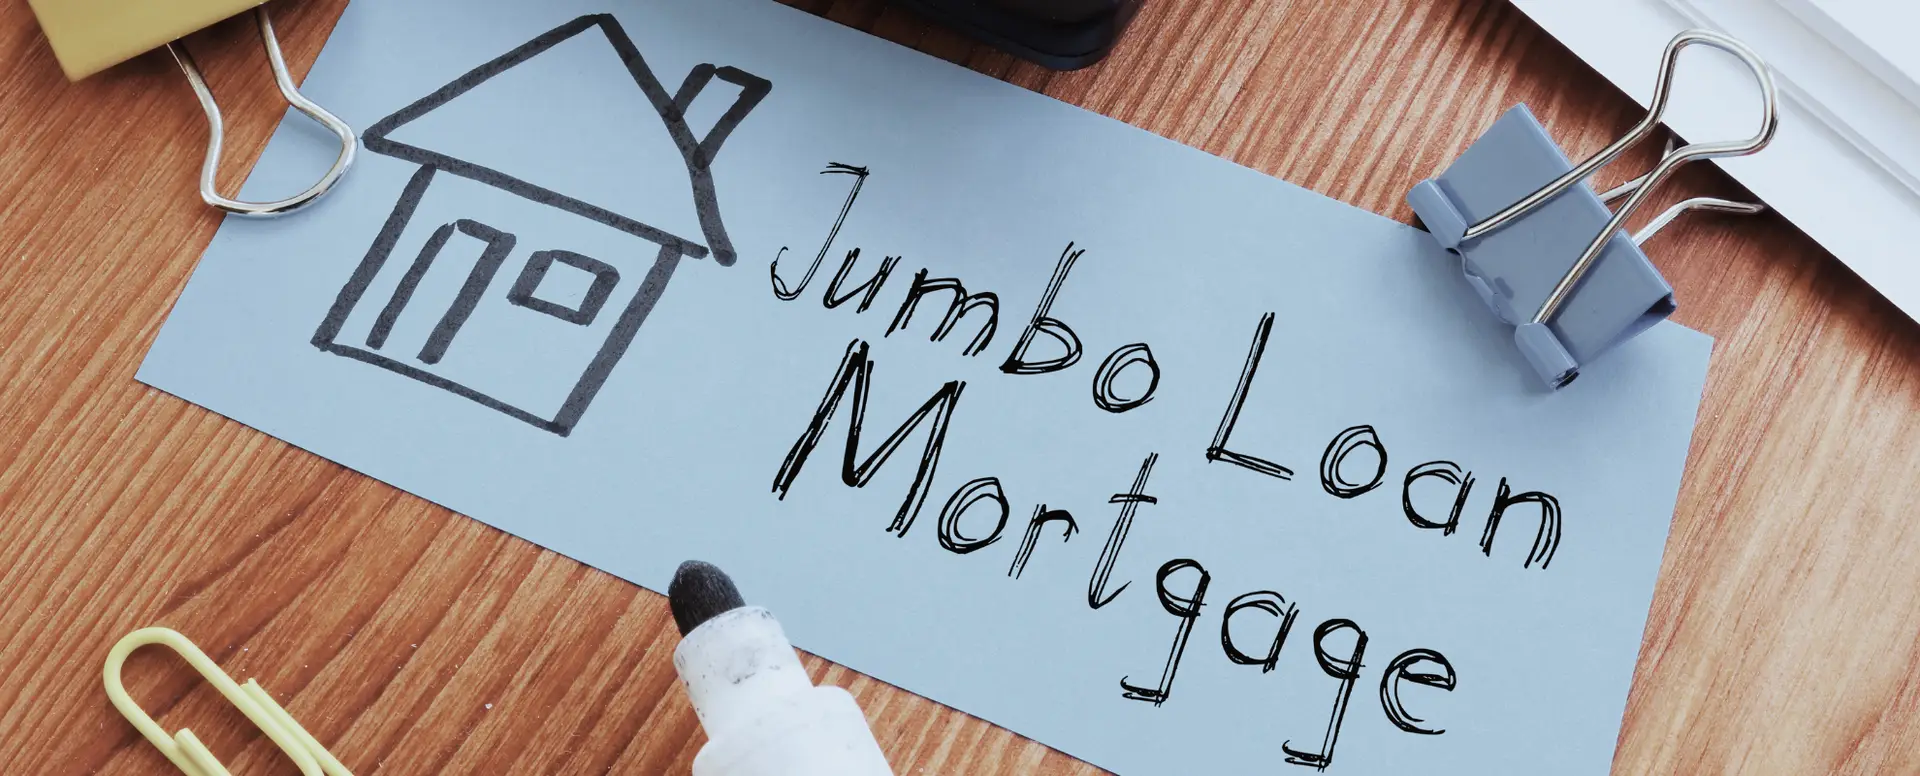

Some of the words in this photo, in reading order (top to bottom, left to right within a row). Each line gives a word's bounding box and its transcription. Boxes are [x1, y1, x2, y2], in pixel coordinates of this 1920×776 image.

[771, 162, 1161, 413] Jumbo
[1206, 312, 1562, 570] Loan
[772, 339, 1457, 773] Mortgage
